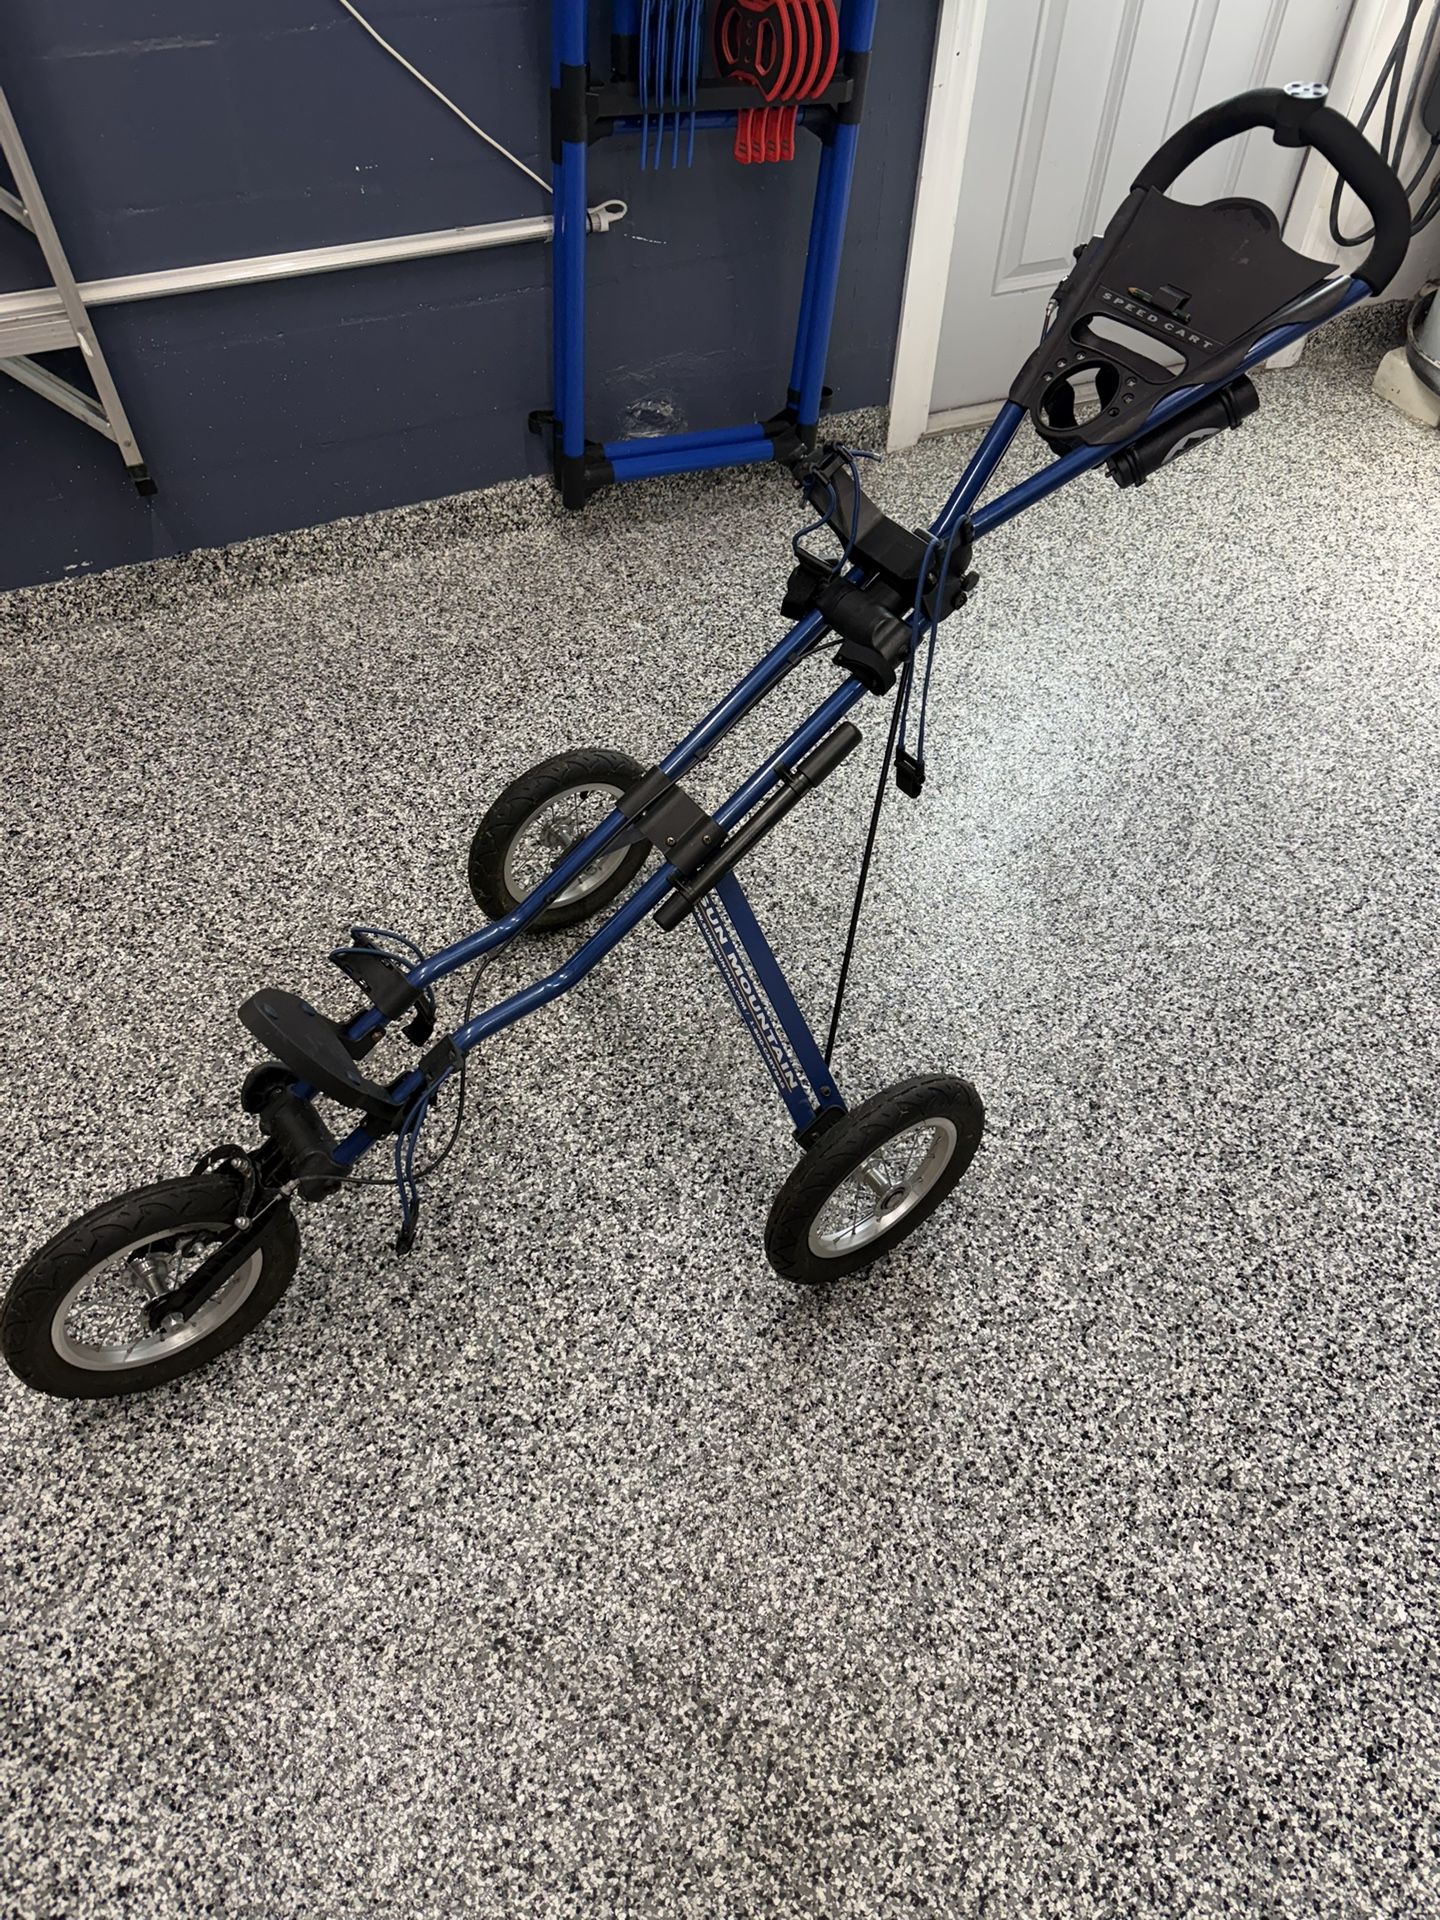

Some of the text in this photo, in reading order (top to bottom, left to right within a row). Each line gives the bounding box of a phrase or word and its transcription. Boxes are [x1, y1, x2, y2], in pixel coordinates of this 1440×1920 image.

[1102, 292, 1213, 349] SPEED CART
[699, 895, 799, 1089] SUN MOUNTAIN
